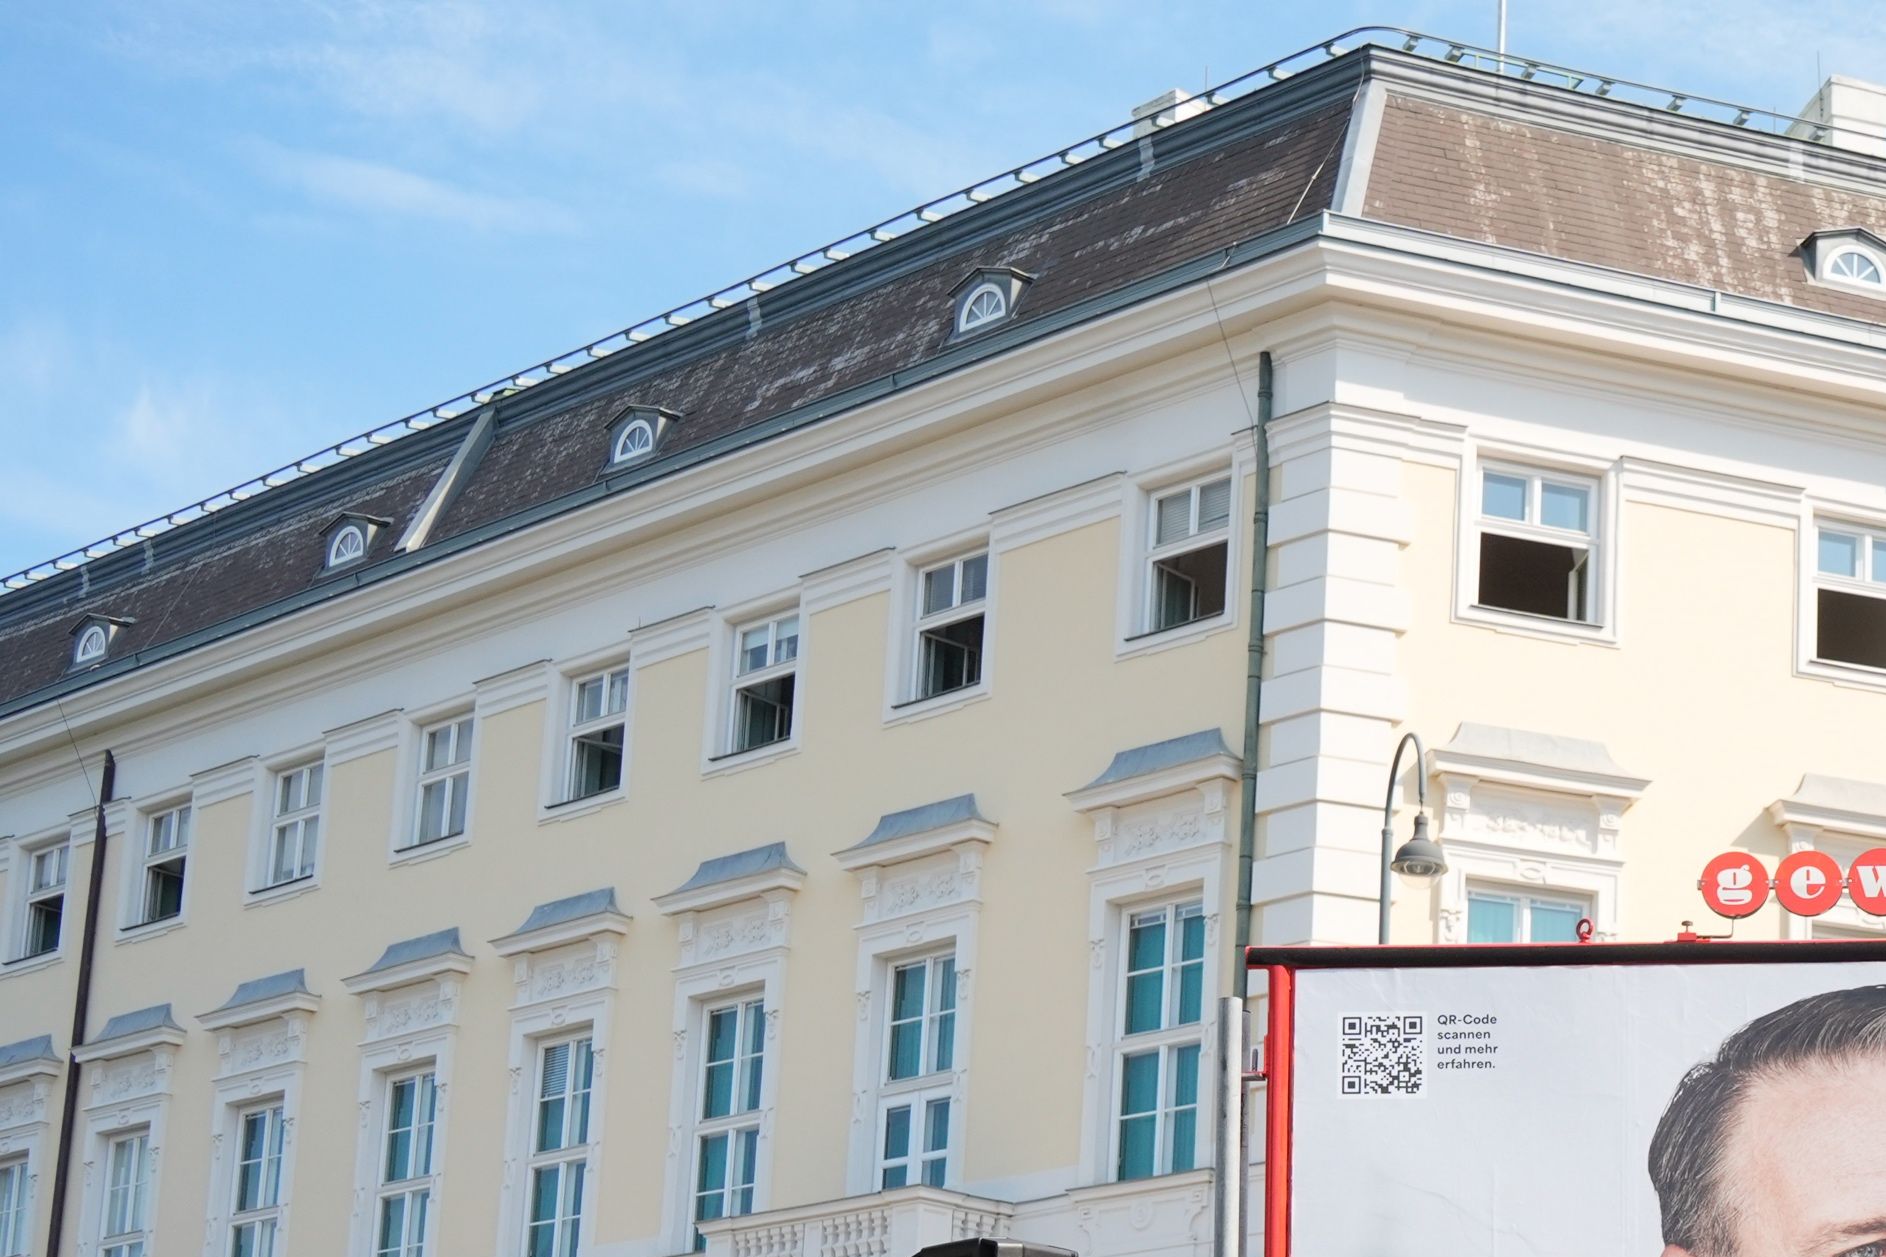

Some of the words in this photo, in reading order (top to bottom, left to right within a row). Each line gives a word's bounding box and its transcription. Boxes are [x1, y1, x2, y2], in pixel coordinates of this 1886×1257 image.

[1437, 1014, 1497, 1025] QR-Code
[1437, 1031, 1491, 1040] scannen
[1437, 1044, 1461, 1055] und
[1465, 1044, 1498, 1054] mehr
[1437, 1058, 1496, 1070] erfahren.
